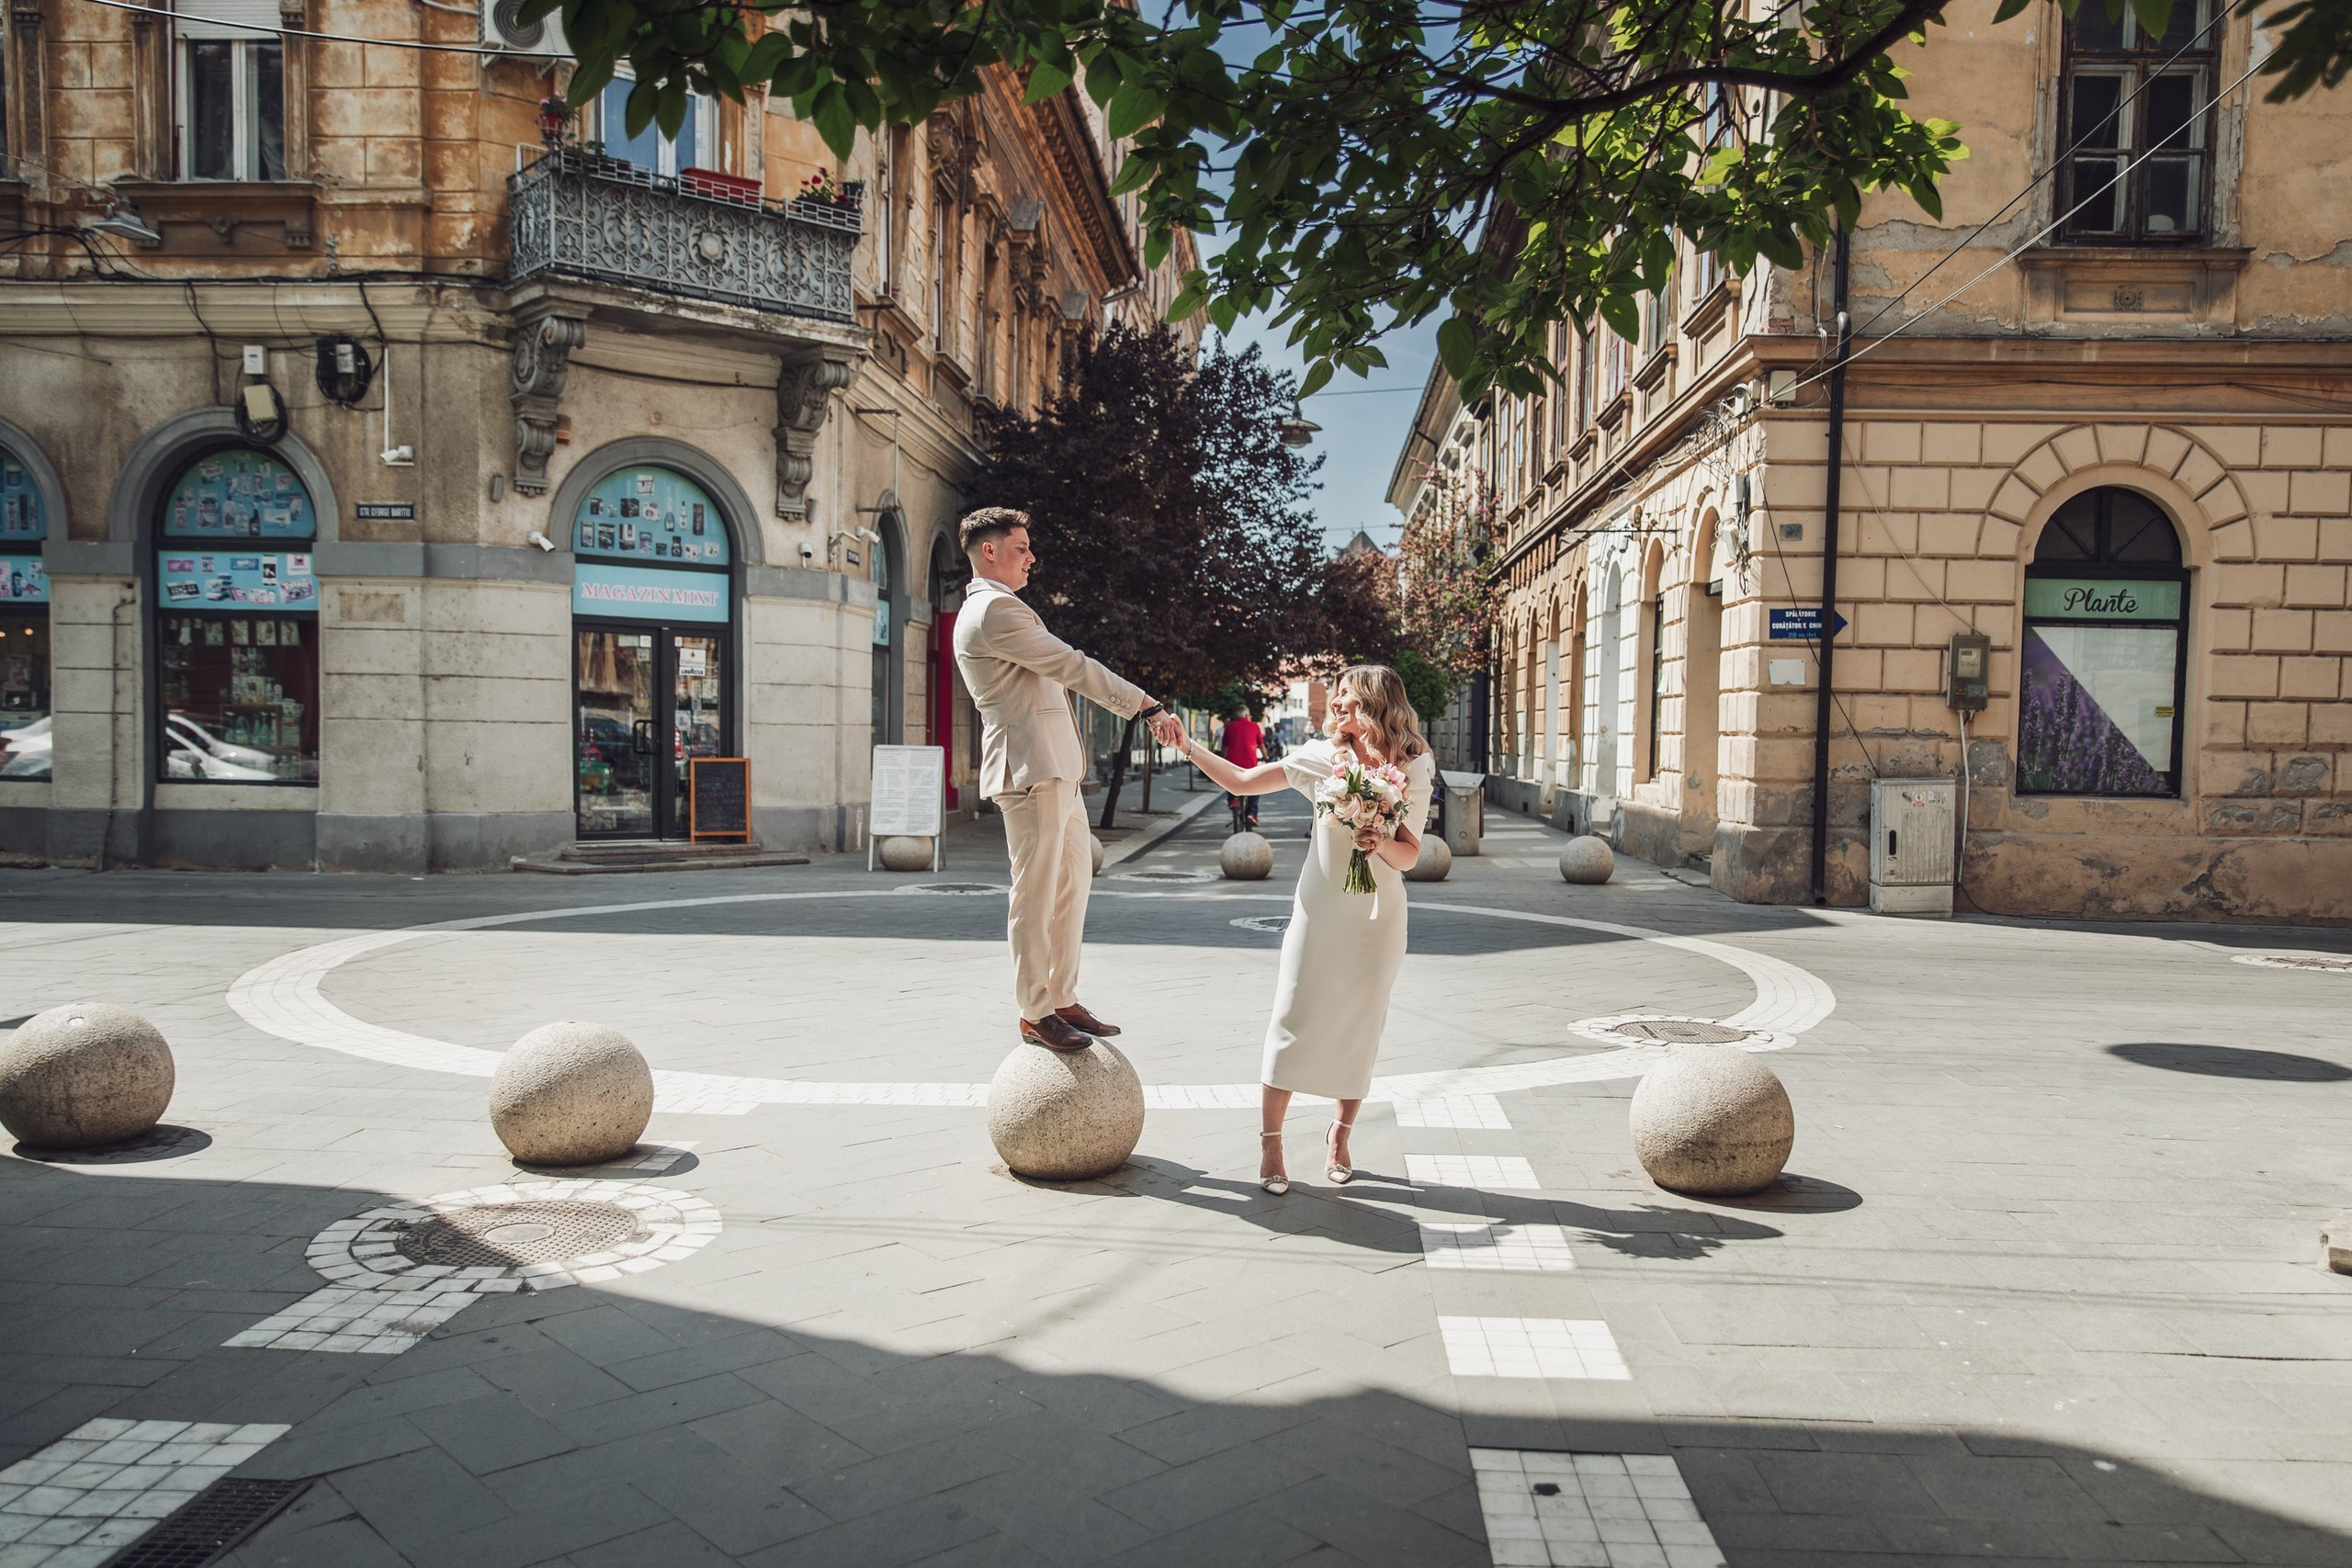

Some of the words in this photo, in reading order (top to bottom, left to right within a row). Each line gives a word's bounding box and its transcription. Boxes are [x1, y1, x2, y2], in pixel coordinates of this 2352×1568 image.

[582, 581, 671, 604] MAGAZIN
[672, 588, 719, 606] MIXT
[2064, 587, 2139, 614] Plante
